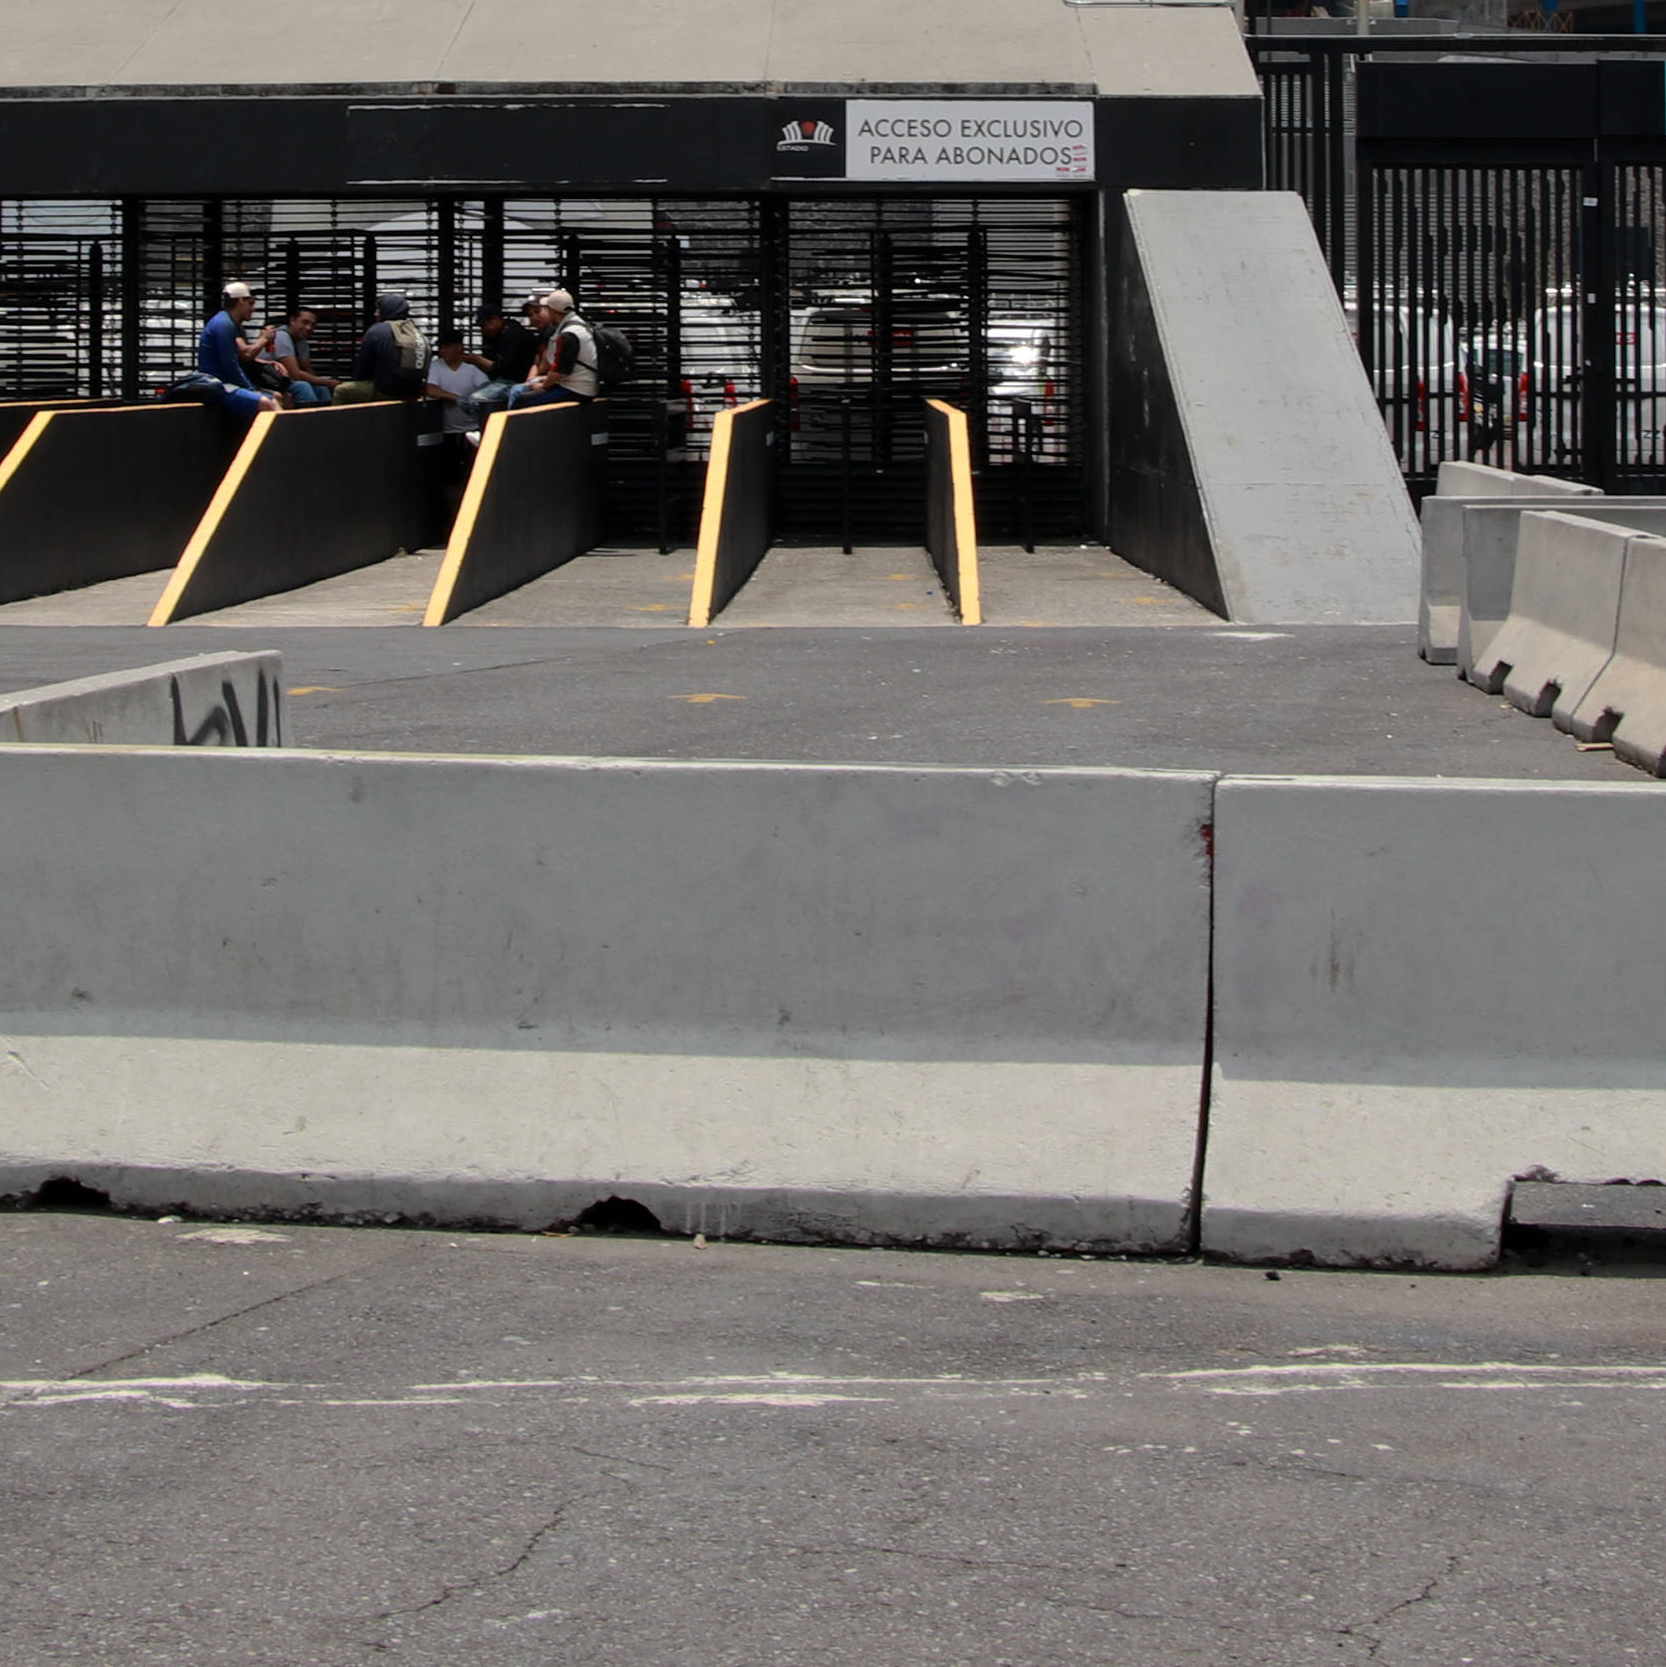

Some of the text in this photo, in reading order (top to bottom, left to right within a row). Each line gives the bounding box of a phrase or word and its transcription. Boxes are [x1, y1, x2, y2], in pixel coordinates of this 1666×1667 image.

[857, 119, 1084, 138] ACCESO EXCLUSIVO
[870, 146, 1073, 166] PARA ABONADOS
